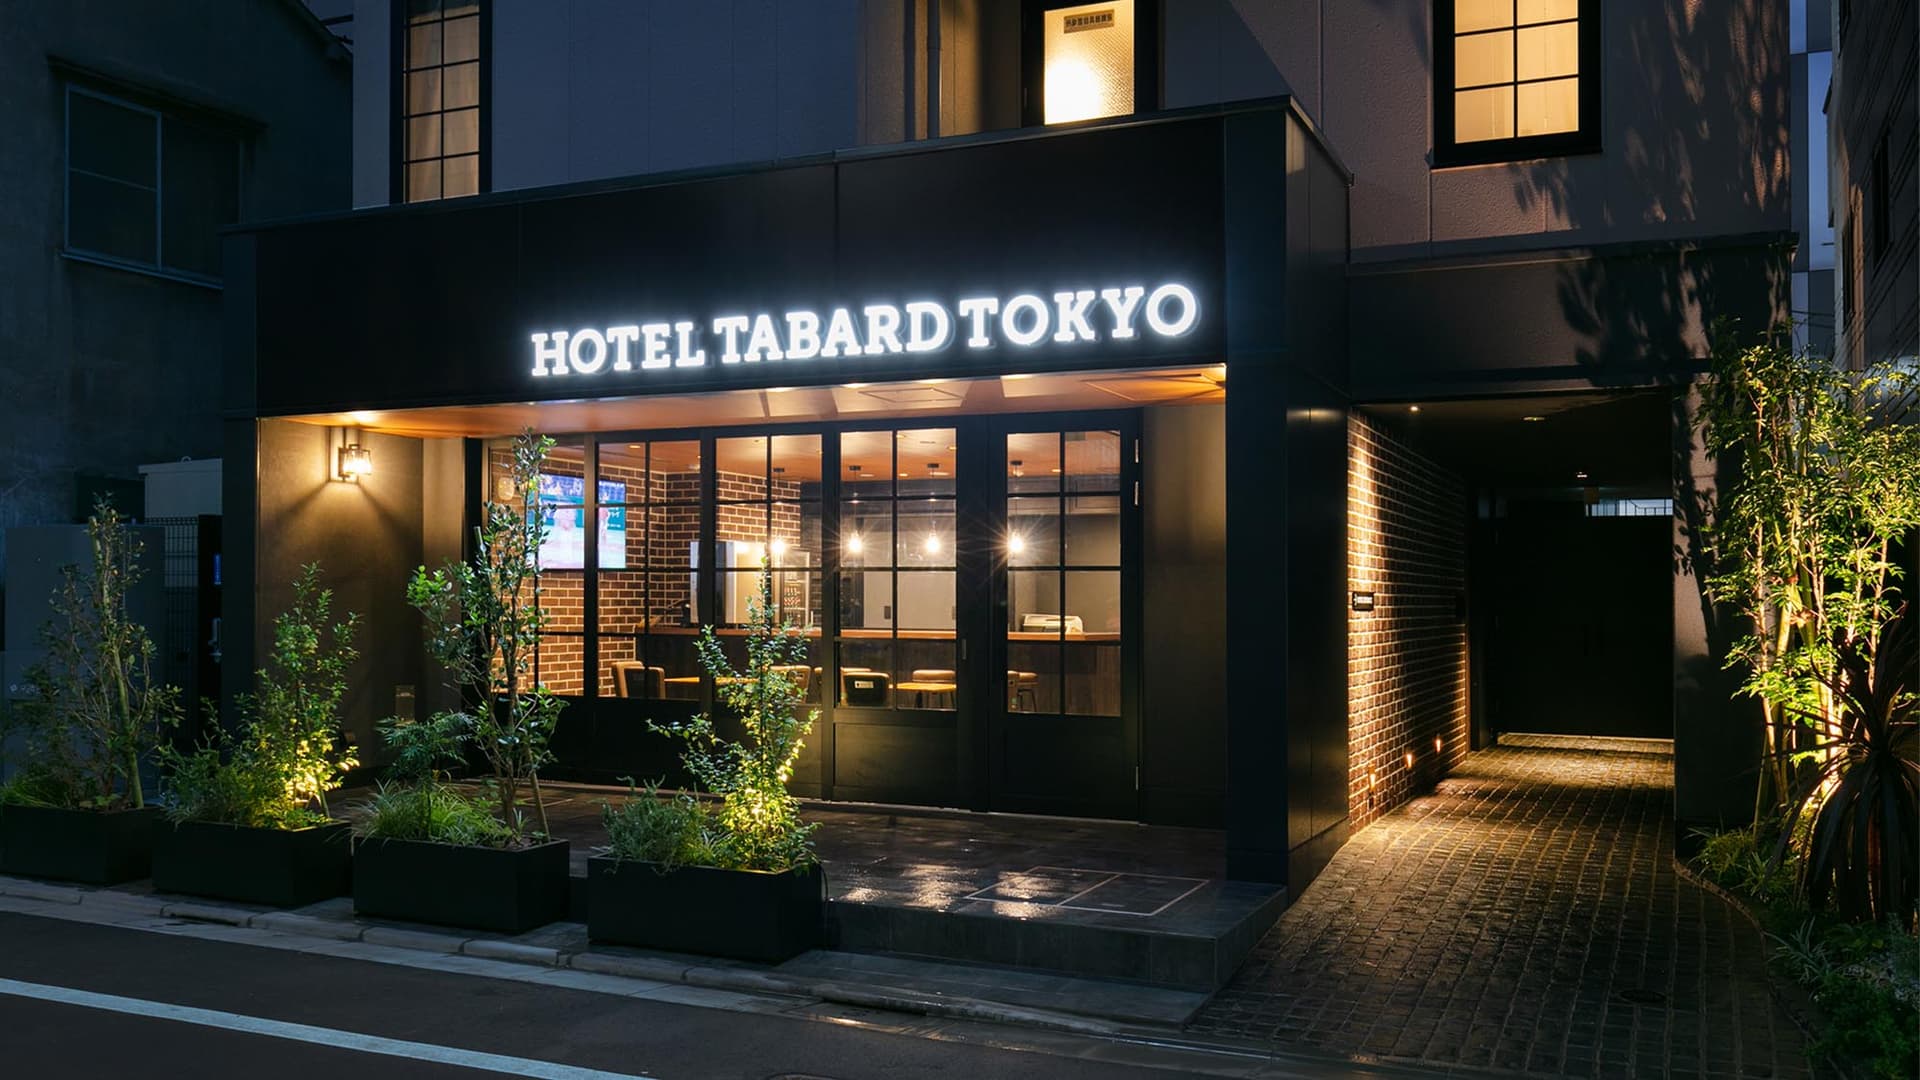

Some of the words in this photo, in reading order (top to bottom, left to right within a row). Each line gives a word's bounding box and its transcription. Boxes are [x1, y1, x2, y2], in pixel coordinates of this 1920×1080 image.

[532, 322, 705, 376] HOTEL
[714, 302, 949, 363] TABARD
[960, 284, 1196, 347] TOKYO
